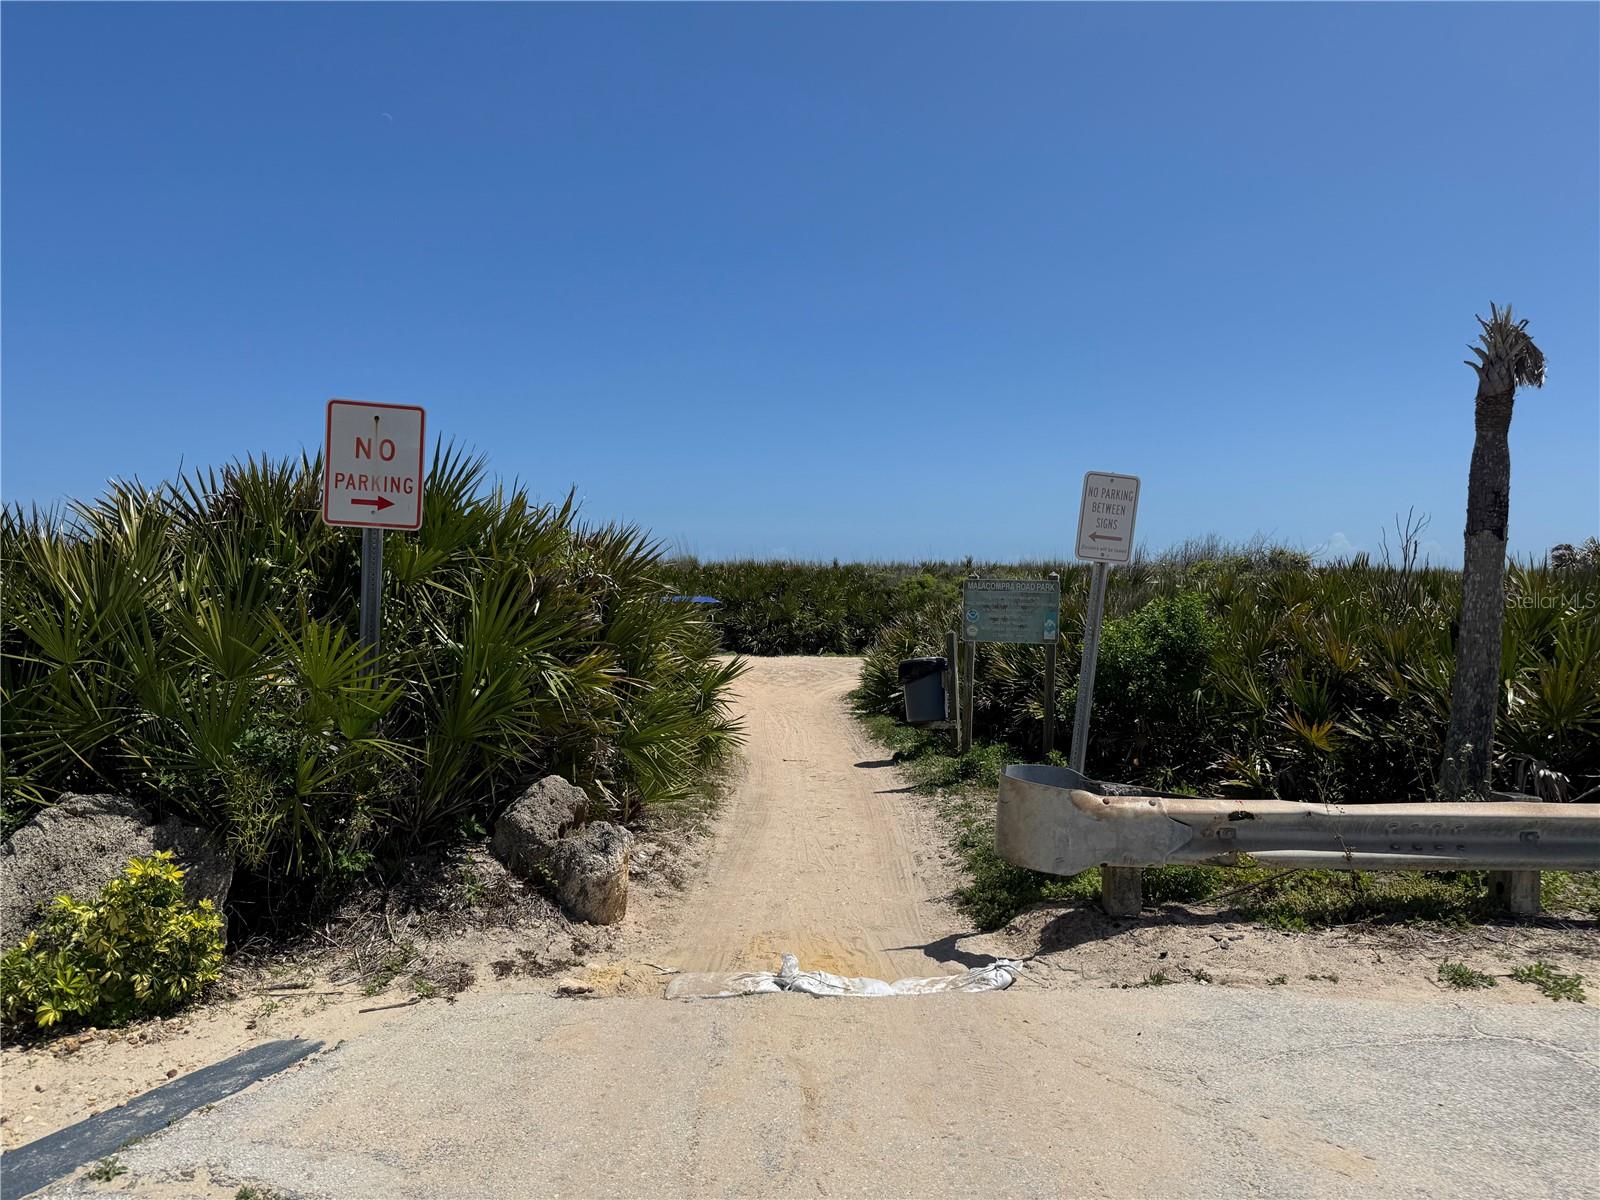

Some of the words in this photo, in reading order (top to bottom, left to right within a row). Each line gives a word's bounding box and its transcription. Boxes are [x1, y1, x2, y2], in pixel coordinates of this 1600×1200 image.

[355, 436, 396, 461] NO
[334, 472, 414, 495] PARKING
[1087, 486, 1099, 498] NO
[1101, 488, 1134, 502] PARKING
[1091, 502, 1126, 516] BETWEEN
[1095, 517, 1118, 530] SIGNS
[967, 582, 1015, 591] MALACOMPRA
[1016, 582, 1036, 591] ROAD
[1036, 583, 1055, 592] PARK
